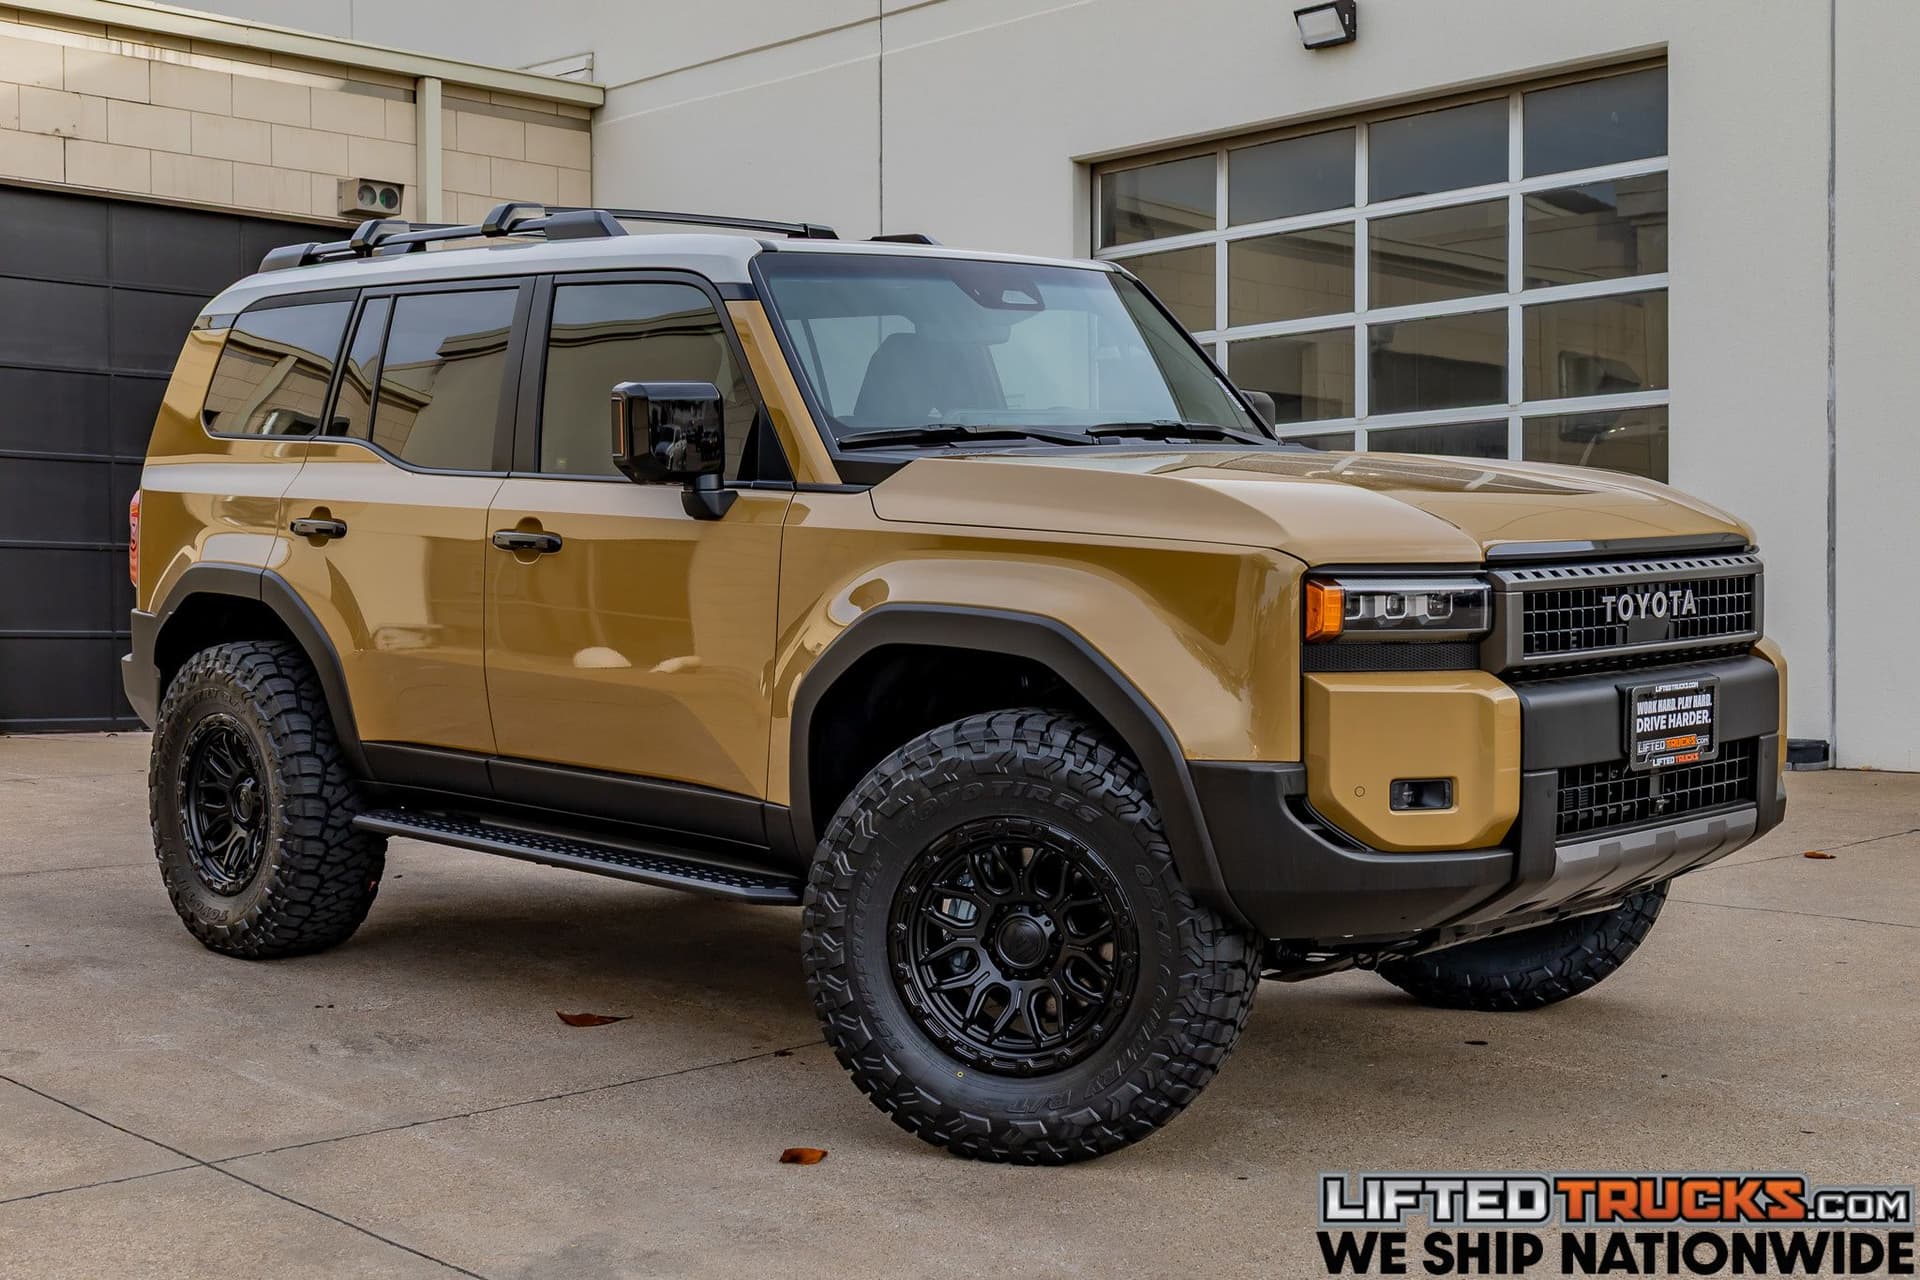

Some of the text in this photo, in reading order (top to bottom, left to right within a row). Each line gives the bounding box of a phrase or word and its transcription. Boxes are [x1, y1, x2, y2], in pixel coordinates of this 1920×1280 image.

[1602, 589, 1697, 623] TOYOTA
[1637, 701, 1657, 716] WORK
[1678, 695, 1693, 711] PLAY
[1692, 693, 1713, 708] HARD.
[1636, 710, 1712, 733] DRIVE HARDER.
[992, 781, 1103, 823] TIRES
